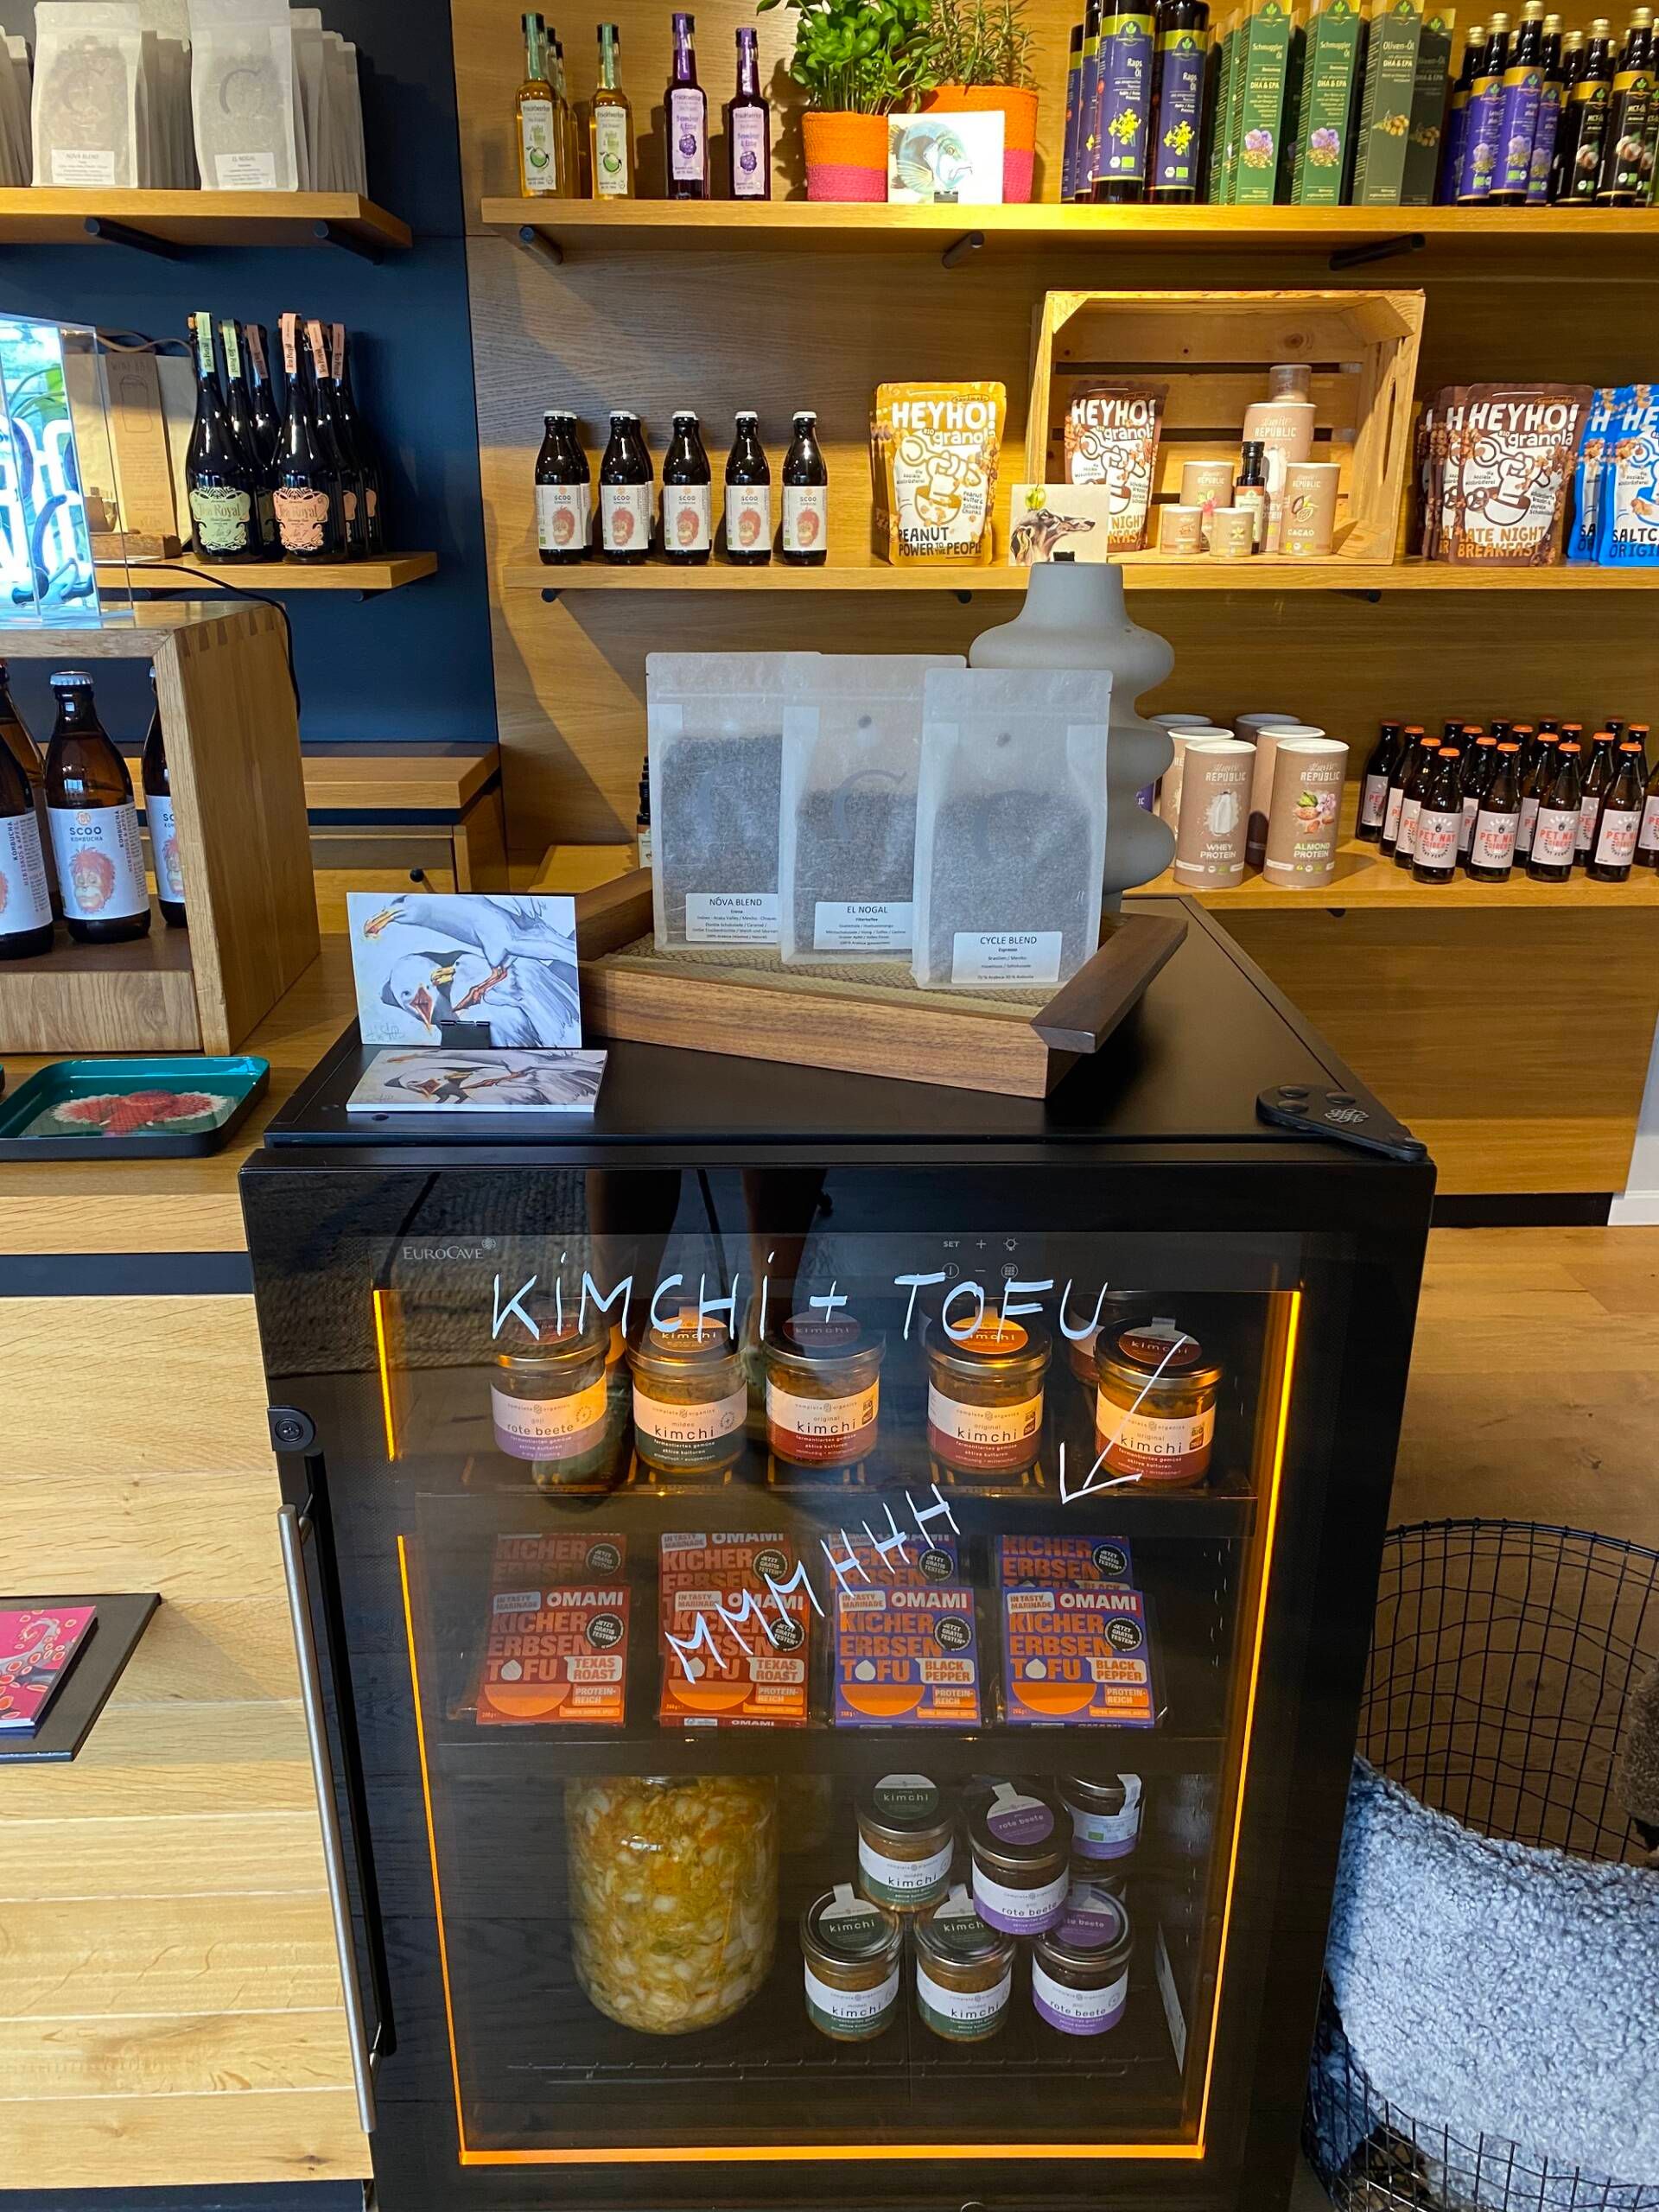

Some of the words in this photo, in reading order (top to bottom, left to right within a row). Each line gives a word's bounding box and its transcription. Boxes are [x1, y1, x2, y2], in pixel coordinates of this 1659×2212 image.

[1382, 39, 1415, 50] Oliven-Öl
[1127, 57, 1142, 67] Raps
[1183, 72, 1198, 82] Raps
[892, 401, 995, 429] HEYHO!
[1071, 399, 1156, 426] HEYHO!
[1469, 403, 1580, 431] HEYHO!
[1255, 428, 1297, 437] REPUBLIC
[1508, 431, 1574, 448] granola
[215, 503, 240, 517] Royal
[295, 504, 317, 518] Royal
[899, 526, 949, 542] PEANUT
[1459, 527, 1494, 543] LATE
[1500, 526, 1546, 543] NIGHT
[899, 543, 934, 556] POWER
[946, 542, 982, 555] PEOPLE
[1205, 772, 1247, 781] REPUBLIC
[1300, 772, 1340, 781] REPUBLIC
[69, 827, 102, 836] SCOO
[114, 810, 124, 848] KOMBUCHA
[1540, 830, 1558, 840] PET
[7, 822, 18, 861] KOMBUCHA
[1419, 830, 1436, 841] PET
[1440, 833, 1456, 842] NAT
[1479, 832, 1498, 842] PET
[1606, 831, 1624, 840] PET
[1009, 936, 1037, 944] BLEND
[810, 1280, 848, 1323] +
[894, 1272, 1108, 1343] TOFU
[1131, 1340, 1188, 1355] kimchi
[506, 1423, 531, 1435] rote
[535, 1423, 574, 1436] beete
[655, 1424, 715, 1440] kimchi
[797, 1419, 855, 1433] kimchi
[957, 1427, 1017, 1443] kimchi
[1137, 1433, 1165, 1441] original
[1121, 1433, 1182, 1453] kimchi
[712, 1533, 783, 1544] OMAMI
[1002, 1536, 1092, 1559] KICHER
[662, 1548, 753, 1572] KICHER
[1099, 1555, 1119, 1565] GRATIS
[1100, 1550, 1118, 1559] JETZT
[925, 1560, 946, 1569] GRATIS
[1003, 1557, 1100, 1580] ERBSEN
[497, 1601, 538, 1610] MARINADE
[546, 1592, 623, 1607] OMAMI
[891, 1592, 968, 1609] OMAMI
[1011, 1601, 1052, 1610] MARINADE
[1060, 1593, 1137, 1611] OMAMI
[493, 1611, 587, 1633] KICHER
[596, 1620, 613, 1629] JETZT
[777, 1622, 795, 1630] JETZT
[840, 1611, 933, 1633] KICHER
[1009, 1613, 1104, 1634] KICHER
[594, 1625, 615, 1635] GRATIS
[775, 1628, 796, 1637] GRATIS
[942, 1628, 963, 1639] GRATIS
[1112, 1629, 1134, 1639] GRATIS
[488, 1635, 592, 1656] ERBSEN
[840, 1636, 942, 1657] ERBSEN
[1010, 1636, 1113, 1657] ERBSEN
[575, 1658, 615, 1669] TEXAS
[757, 1660, 797, 1670] TEXAS
[925, 1661, 964, 1670] BLACK
[1096, 1661, 1135, 1670] BLACK
[574, 1669, 615, 1680] ROAST
[756, 1670, 798, 1681] ROAST
[925, 1671, 970, 1681] PEPPER
[1096, 1670, 1142, 1681] PEPPER
[935, 1689, 974, 1698] PROTEIN-
[1106, 1688, 1147, 1697] PROTEIN-
[575, 1695, 601, 1704] REICH
[999, 1820, 1017, 1829] rote
[1019, 1815, 1043, 1825] beete
[888, 1873, 937, 1887] kimchi
[1002, 1907, 1025, 1916] rote
[1029, 1901, 1058, 1916] beete
[830, 1919, 874, 1932] kimchi
[944, 1921, 984, 1932] kimch
[832, 2003, 881, 2017] kimchi
[951, 2001, 999, 2018] kimchi
[1050, 2001, 1071, 2014] rote
[1075, 2008, 1106, 2018] beete
